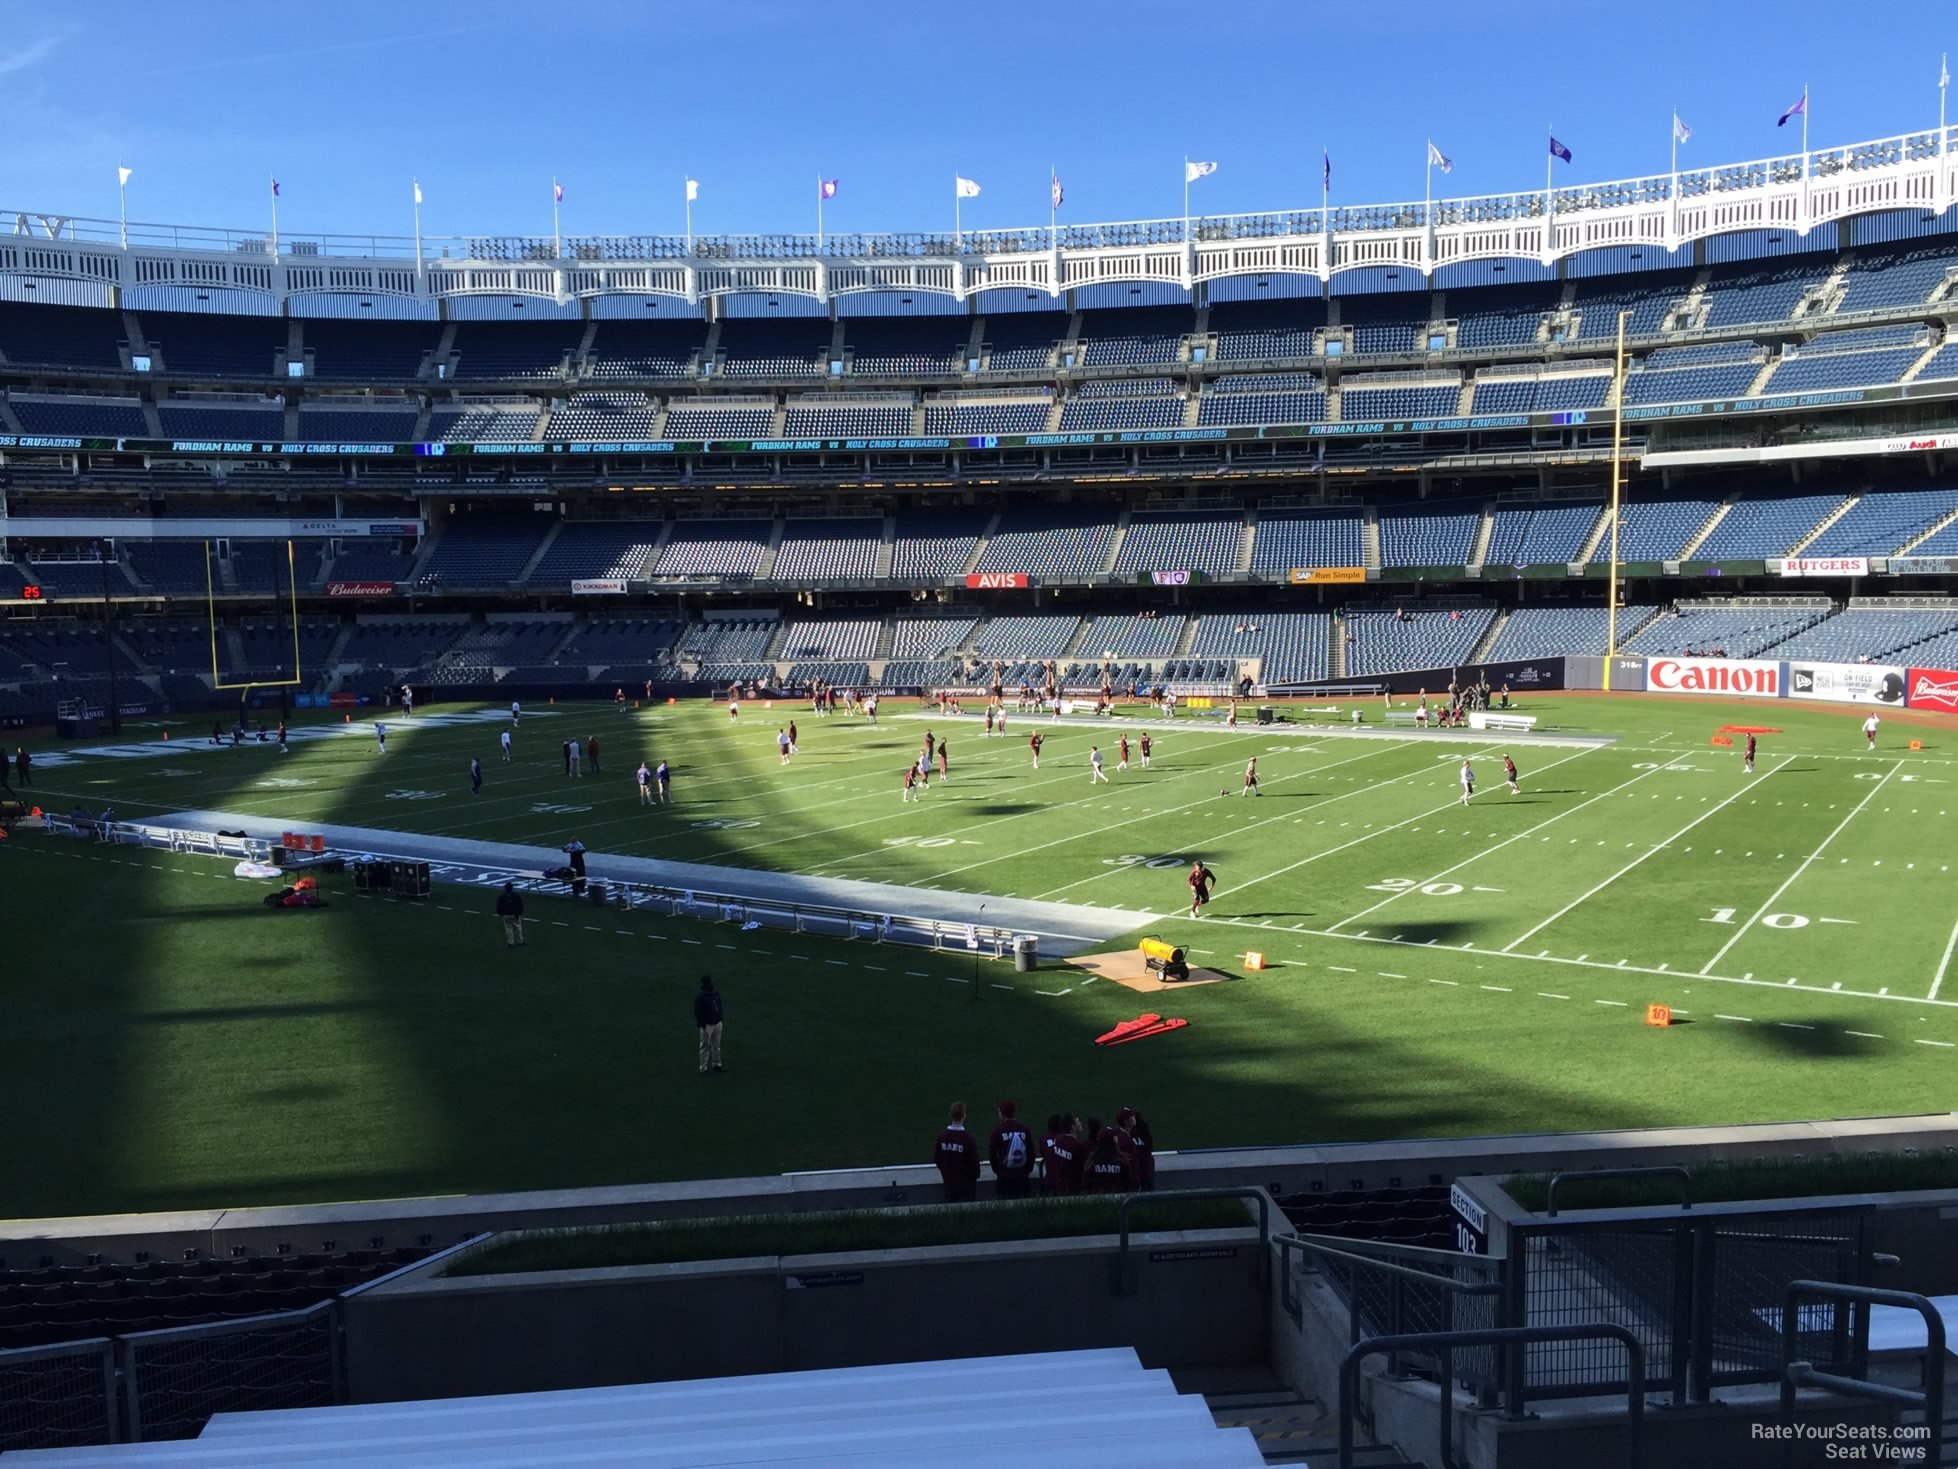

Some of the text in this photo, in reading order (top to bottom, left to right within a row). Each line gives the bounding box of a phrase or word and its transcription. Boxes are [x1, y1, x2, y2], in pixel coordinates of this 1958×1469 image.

[1734, 391, 1864, 412] HOLY CROSS CRUSADERS
[1672, 404, 1703, 415] RAMS
[1309, 425, 1355, 434] FORDHAM
[1356, 423, 1384, 433] RAMS
[1412, 416, 1529, 431] HOLY CROSS CRUSADERS
[1025, 435, 1067, 444] FORDHAM
[1068, 434, 1095, 443] RAMS
[1119, 430, 1228, 441] HOLY CROSS CRUSADERS
[19, 438, 82, 448] CRUSADERS
[172, 442, 222, 451] FORDHAM
[223, 443, 253, 452] RAMS
[473, 444, 516, 453] FORDHAM
[517, 444, 544, 453] RAMS
[569, 443, 674, 452] HOLY CROSS CRUSADERS
[751, 441, 794, 450] FORDHAM
[795, 441, 821, 450] RAMS
[846, 439, 949, 449] HOLY CROSS CRUSADERS
[1909, 439, 1937, 449] Audi
[280, 444, 394, 454] HOLY CROSS CRUSADERS
[1787, 560, 1861, 570] RUTGERS
[978, 574, 1016, 587] AVIS
[1296, 571, 1311, 580] SAP
[1333, 571, 1360, 580] Simple
[23, 586, 40, 598] 25
[327, 583, 392, 597] Budweiser
[1650, 661, 1776, 692] Canon
[1856, 674, 1872, 682] FIELD
[119, 707, 147, 715] STADIUM
[1102, 854, 1185, 869] 30
[1364, 878, 1464, 896] 20
[1698, 908, 1810, 929] 10
[1652, 1008, 1666, 1020] 10
[941, 1142, 964, 1153] BAND
[1094, 1164, 1121, 1175] BAND
[1451, 1190, 1483, 1229] SECTION
[1456, 1222, 1477, 1254] 103
